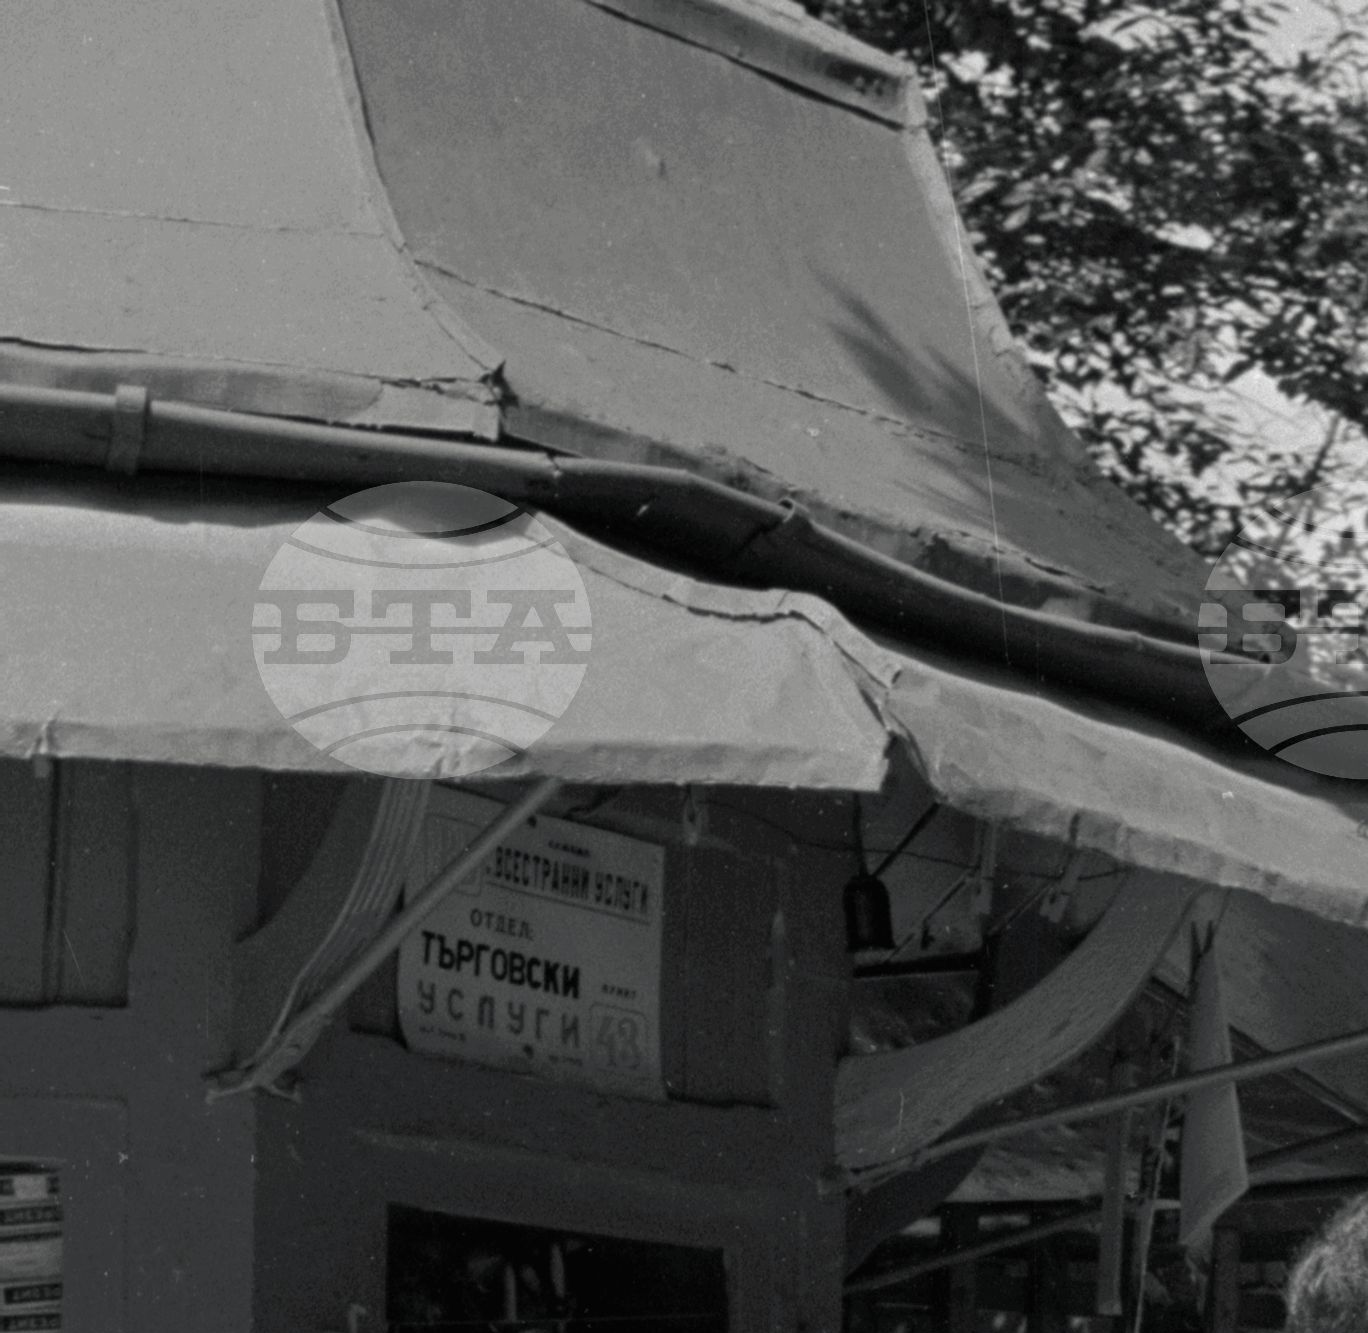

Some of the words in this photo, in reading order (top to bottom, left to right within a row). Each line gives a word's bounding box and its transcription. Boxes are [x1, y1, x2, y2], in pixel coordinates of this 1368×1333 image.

[594, 870, 649, 916] УСЛУГИ
[421, 930, 581, 1000] ТЪРГОВСКИ
[417, 979, 580, 1049] УСЛУГИ
